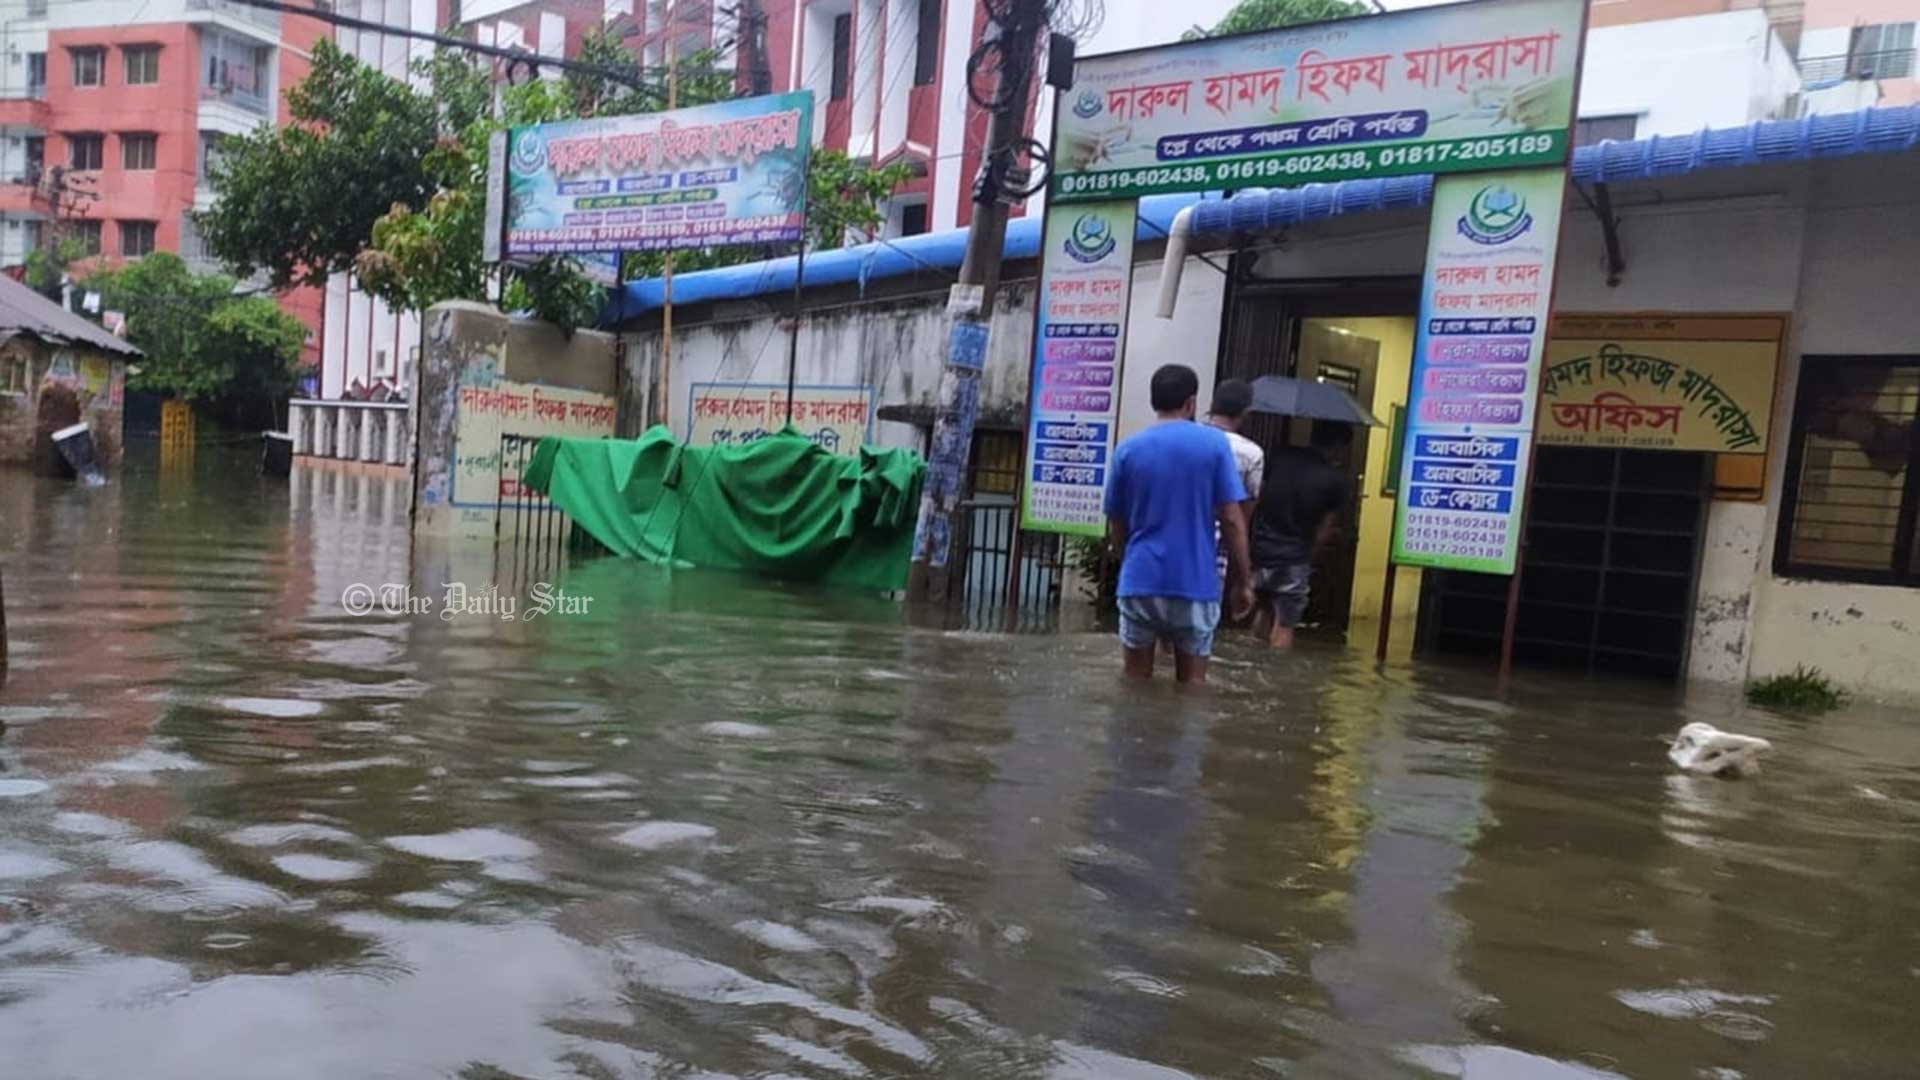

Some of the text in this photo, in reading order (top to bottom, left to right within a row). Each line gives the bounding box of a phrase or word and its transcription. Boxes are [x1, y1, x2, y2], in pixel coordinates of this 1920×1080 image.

[1107, 80, 1193, 122] দারুল
[1203, 68, 1286, 116] হামদ্
[1296, 48, 1394, 103] হিফয
[1194, 133, 1243, 152] থেকে
[1250, 127, 1301, 147] পঞ্চম
[1363, 113, 1420, 135] পর্যন্ত
[1075, 133, 1553, 191] 01819-602438, 01619-602438, 01817-205189
[1437, 267, 1488, 285] দারুল
[1551, 391, 1684, 436] অফিস
[1597, 344, 1679, 394] হিফজ
[1678, 368, 1761, 451] মাদরাসা
[1426, 437, 1505, 457] আবাসিক
[1422, 463, 1502, 484] অনাবাসিক
